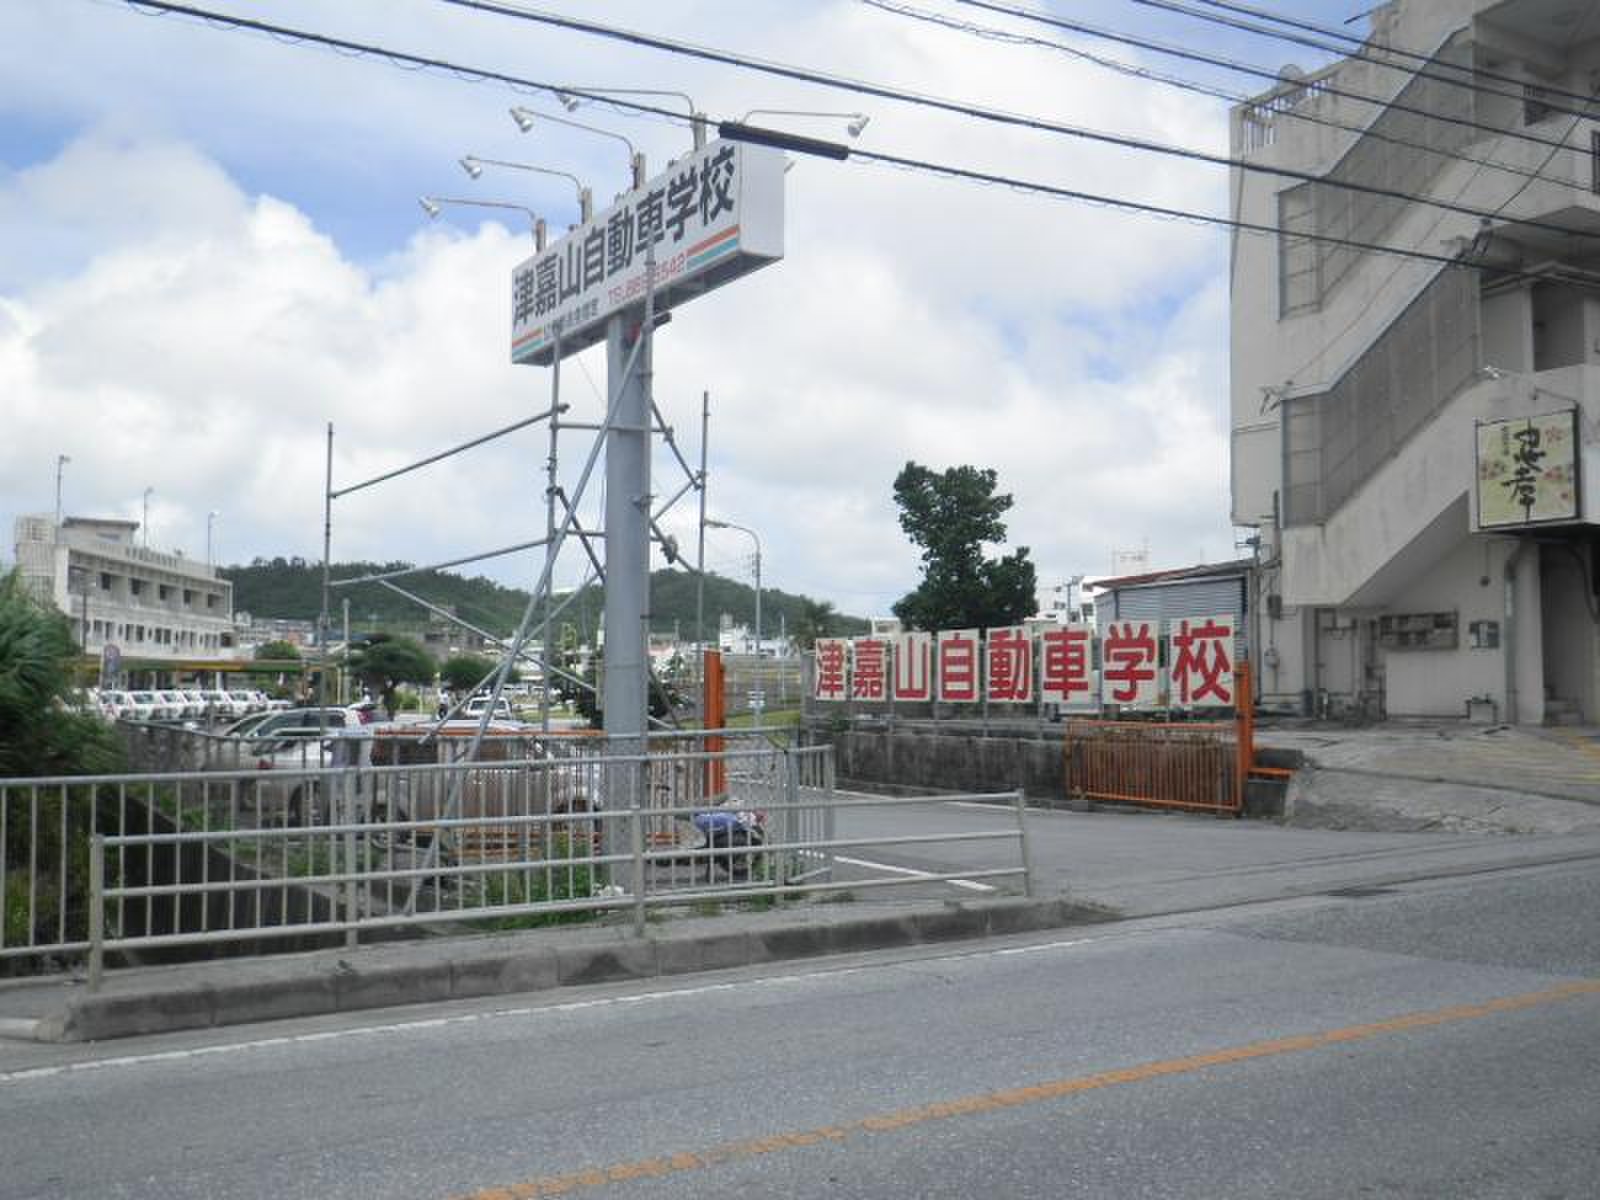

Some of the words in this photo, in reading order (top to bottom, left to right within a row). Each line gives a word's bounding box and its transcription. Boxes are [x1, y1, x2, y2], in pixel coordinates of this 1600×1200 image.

[513, 146, 735, 327] 津嘉山自動車学校
[816, 620, 1232, 704] 津嘉山自動車学校
